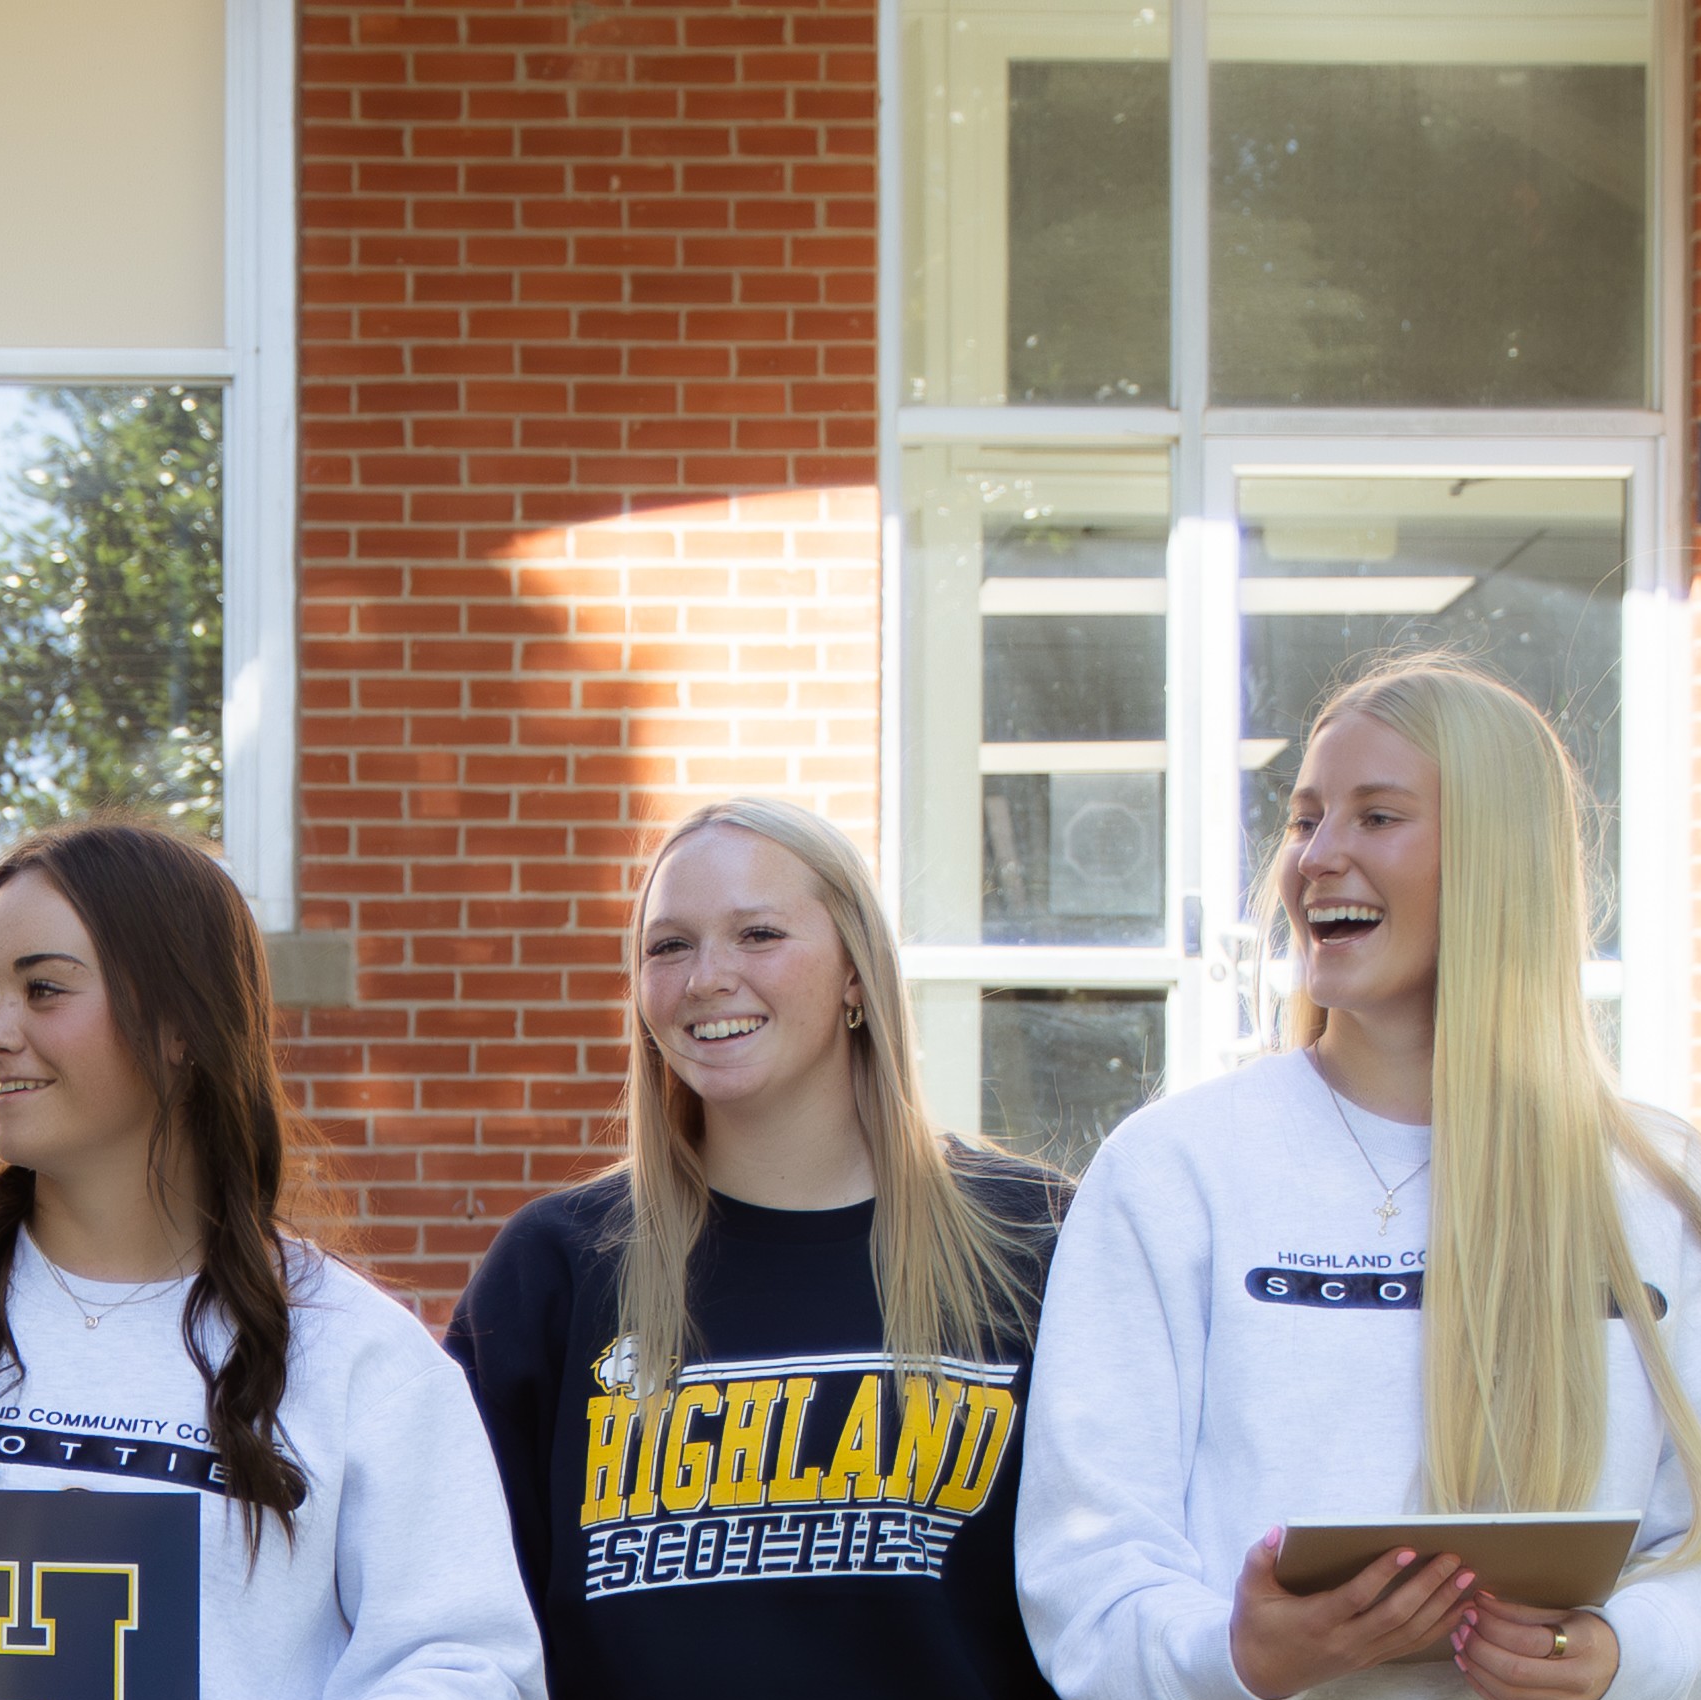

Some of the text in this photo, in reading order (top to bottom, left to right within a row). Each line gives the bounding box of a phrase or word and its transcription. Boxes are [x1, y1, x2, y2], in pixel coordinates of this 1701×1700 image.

[1278, 1251, 1392, 1269] HIGHLAND
[28, 1406, 169, 1436] COMMUNITY
[579, 1374, 1018, 1529] HIGHLAND
[597, 1510, 933, 1591] SCOTTIES
